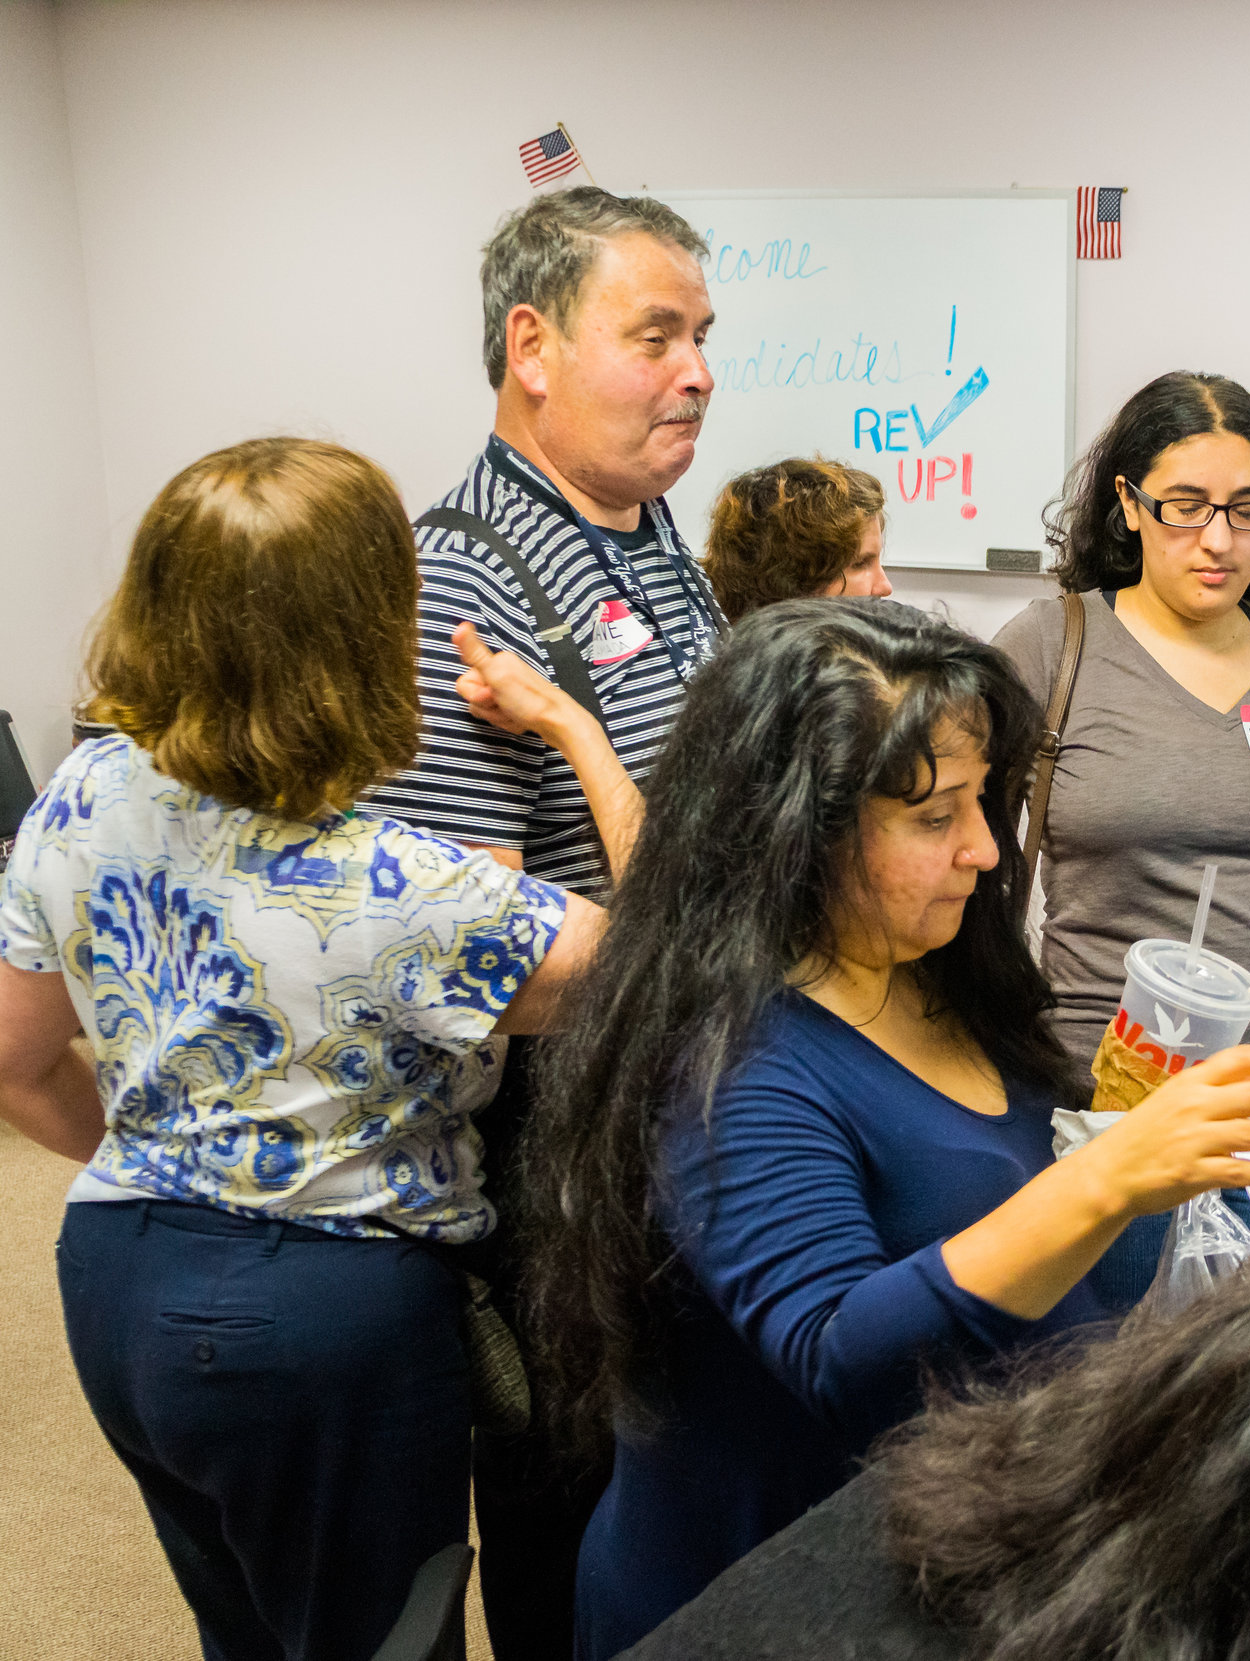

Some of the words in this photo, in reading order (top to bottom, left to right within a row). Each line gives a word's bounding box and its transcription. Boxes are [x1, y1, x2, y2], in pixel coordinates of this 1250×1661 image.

[705, 228, 828, 284] lcome
[707, 332, 935, 393] ndidates
[854, 365, 990, 453] REV
[898, 453, 978, 520] UP!
[601, 538, 621, 565] New
[608, 561, 641, 592] York
